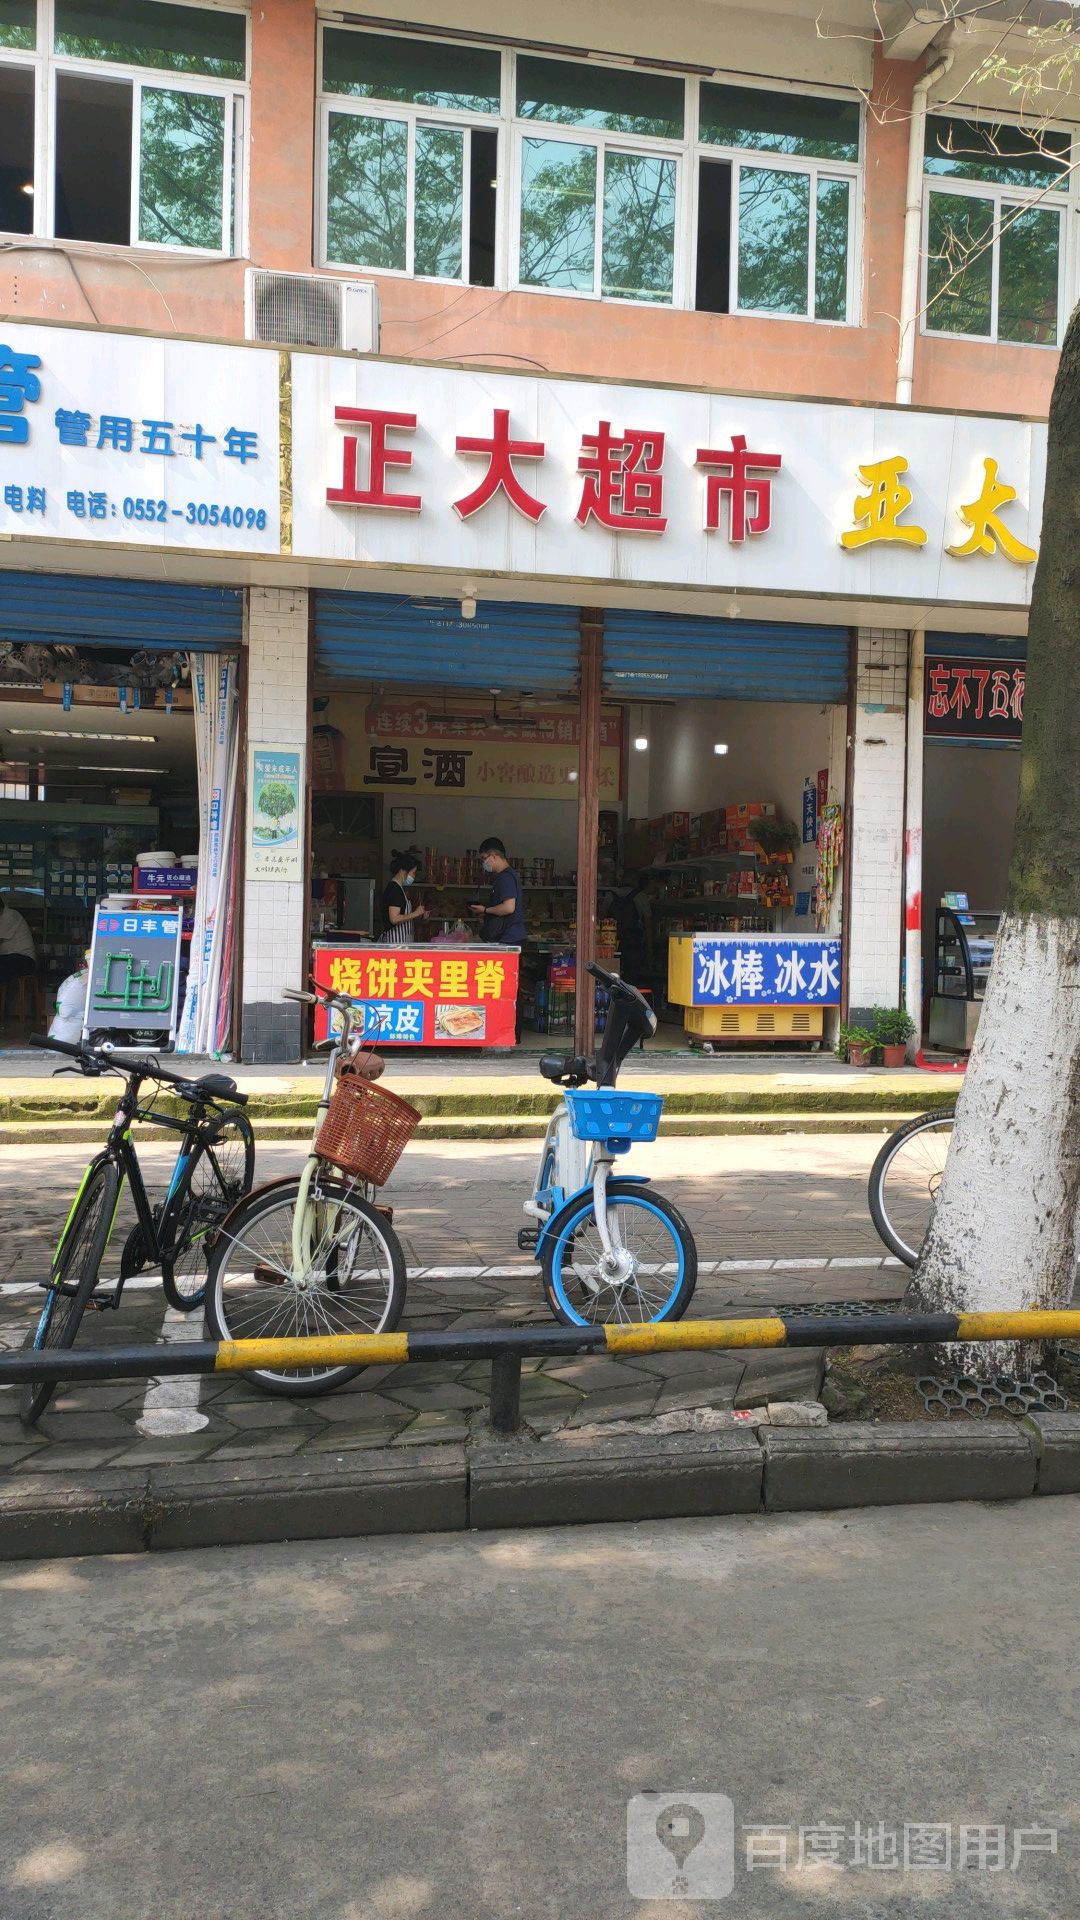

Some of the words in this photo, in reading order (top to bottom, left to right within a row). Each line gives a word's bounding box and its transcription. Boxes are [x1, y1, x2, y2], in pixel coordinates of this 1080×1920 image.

[55, 407, 259, 465] 管用五十年
[325, 405, 783, 543] 正大超市
[4, 484, 47, 515] 电料
[837, 454, 1039, 565] 亚太
[363, 745, 474, 788] 宣酒
[123, 918, 178, 934] 日丰管
[329, 957, 505, 1000] 烧饼夹里脊
[697, 949, 765, 997] 冰棒
[774, 949, 840, 997] 冰水
[367, 1003, 420, 1034] 凉皮
